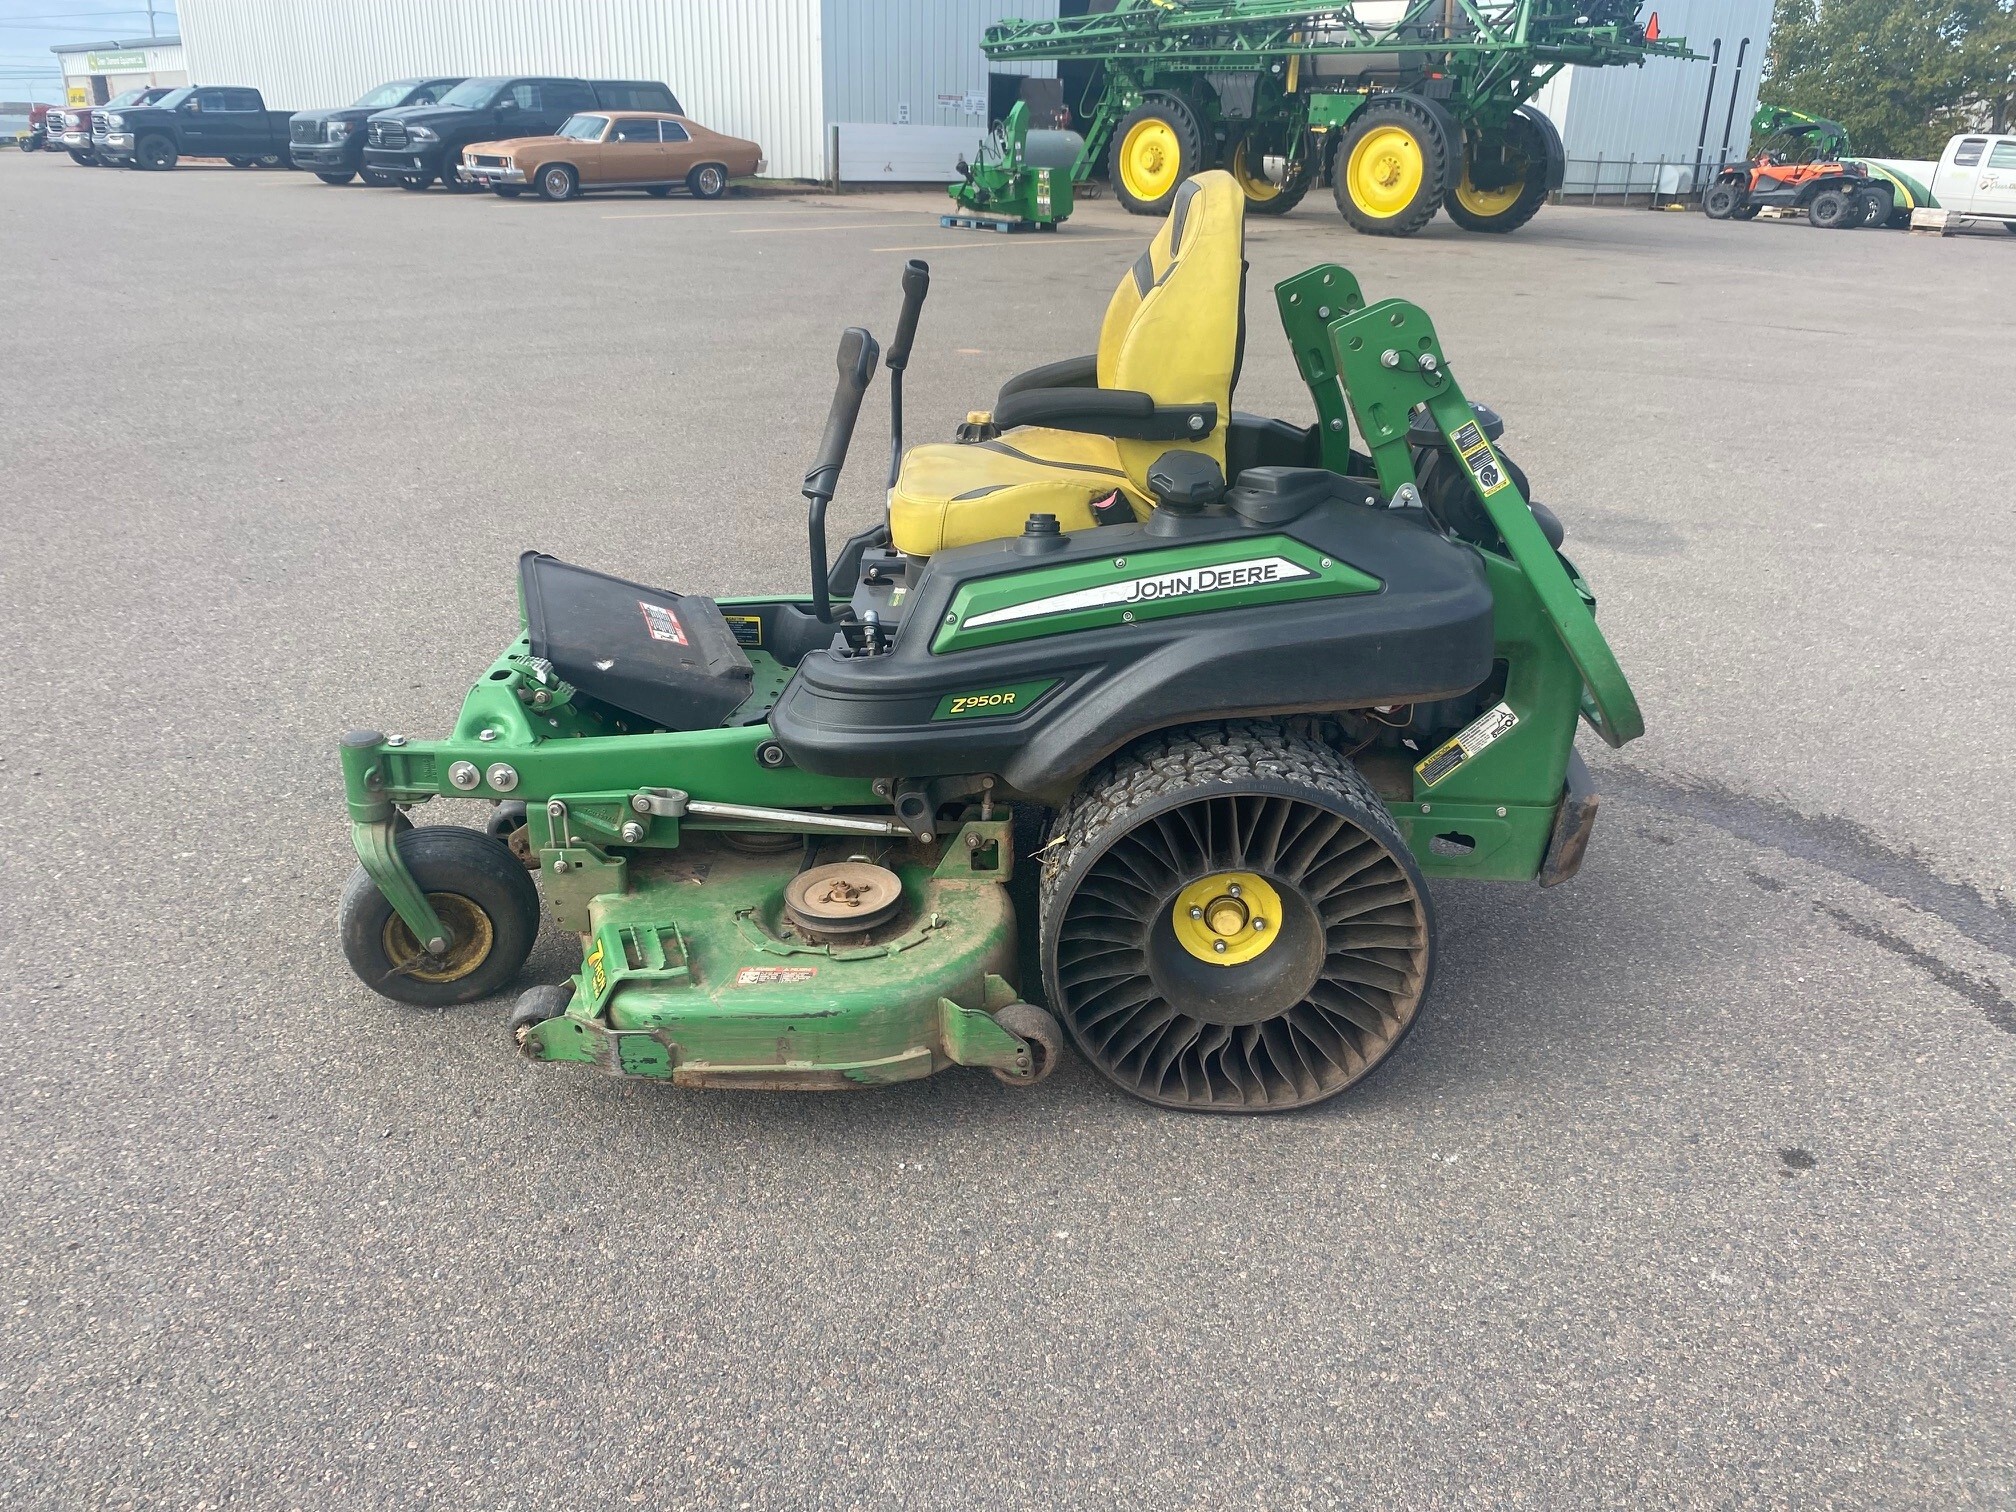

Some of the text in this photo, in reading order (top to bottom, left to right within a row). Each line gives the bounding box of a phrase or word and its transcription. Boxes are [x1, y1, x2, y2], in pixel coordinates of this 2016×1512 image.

[1127, 564, 1279, 601] JOHN DEERE
[950, 692, 1016, 714] Z950R
